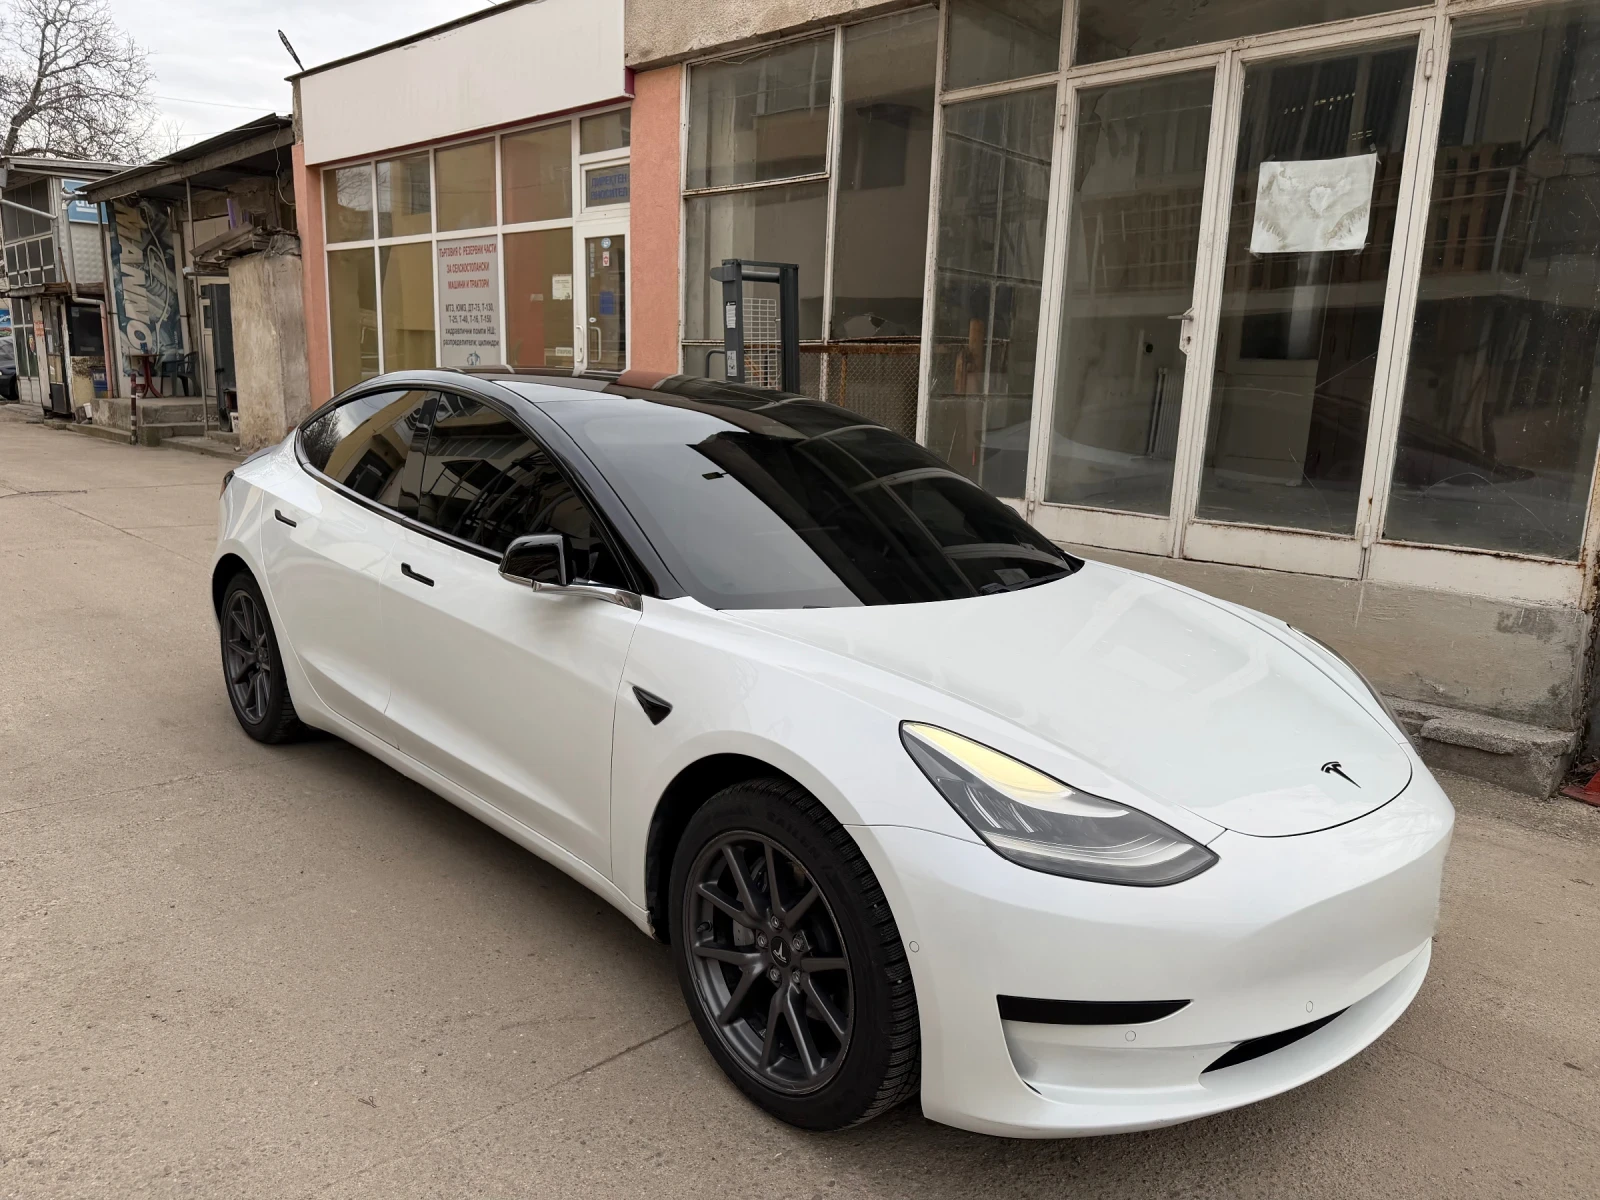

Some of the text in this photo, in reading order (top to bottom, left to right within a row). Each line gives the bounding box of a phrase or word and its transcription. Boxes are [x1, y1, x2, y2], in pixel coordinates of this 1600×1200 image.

[591, 173, 627, 188] ДИРЕКТЕН
[484, 243, 497, 254] ЧАСТИ
[446, 264, 452, 274] ЗА
[470, 278, 489, 288] ТРАКТОРИ
